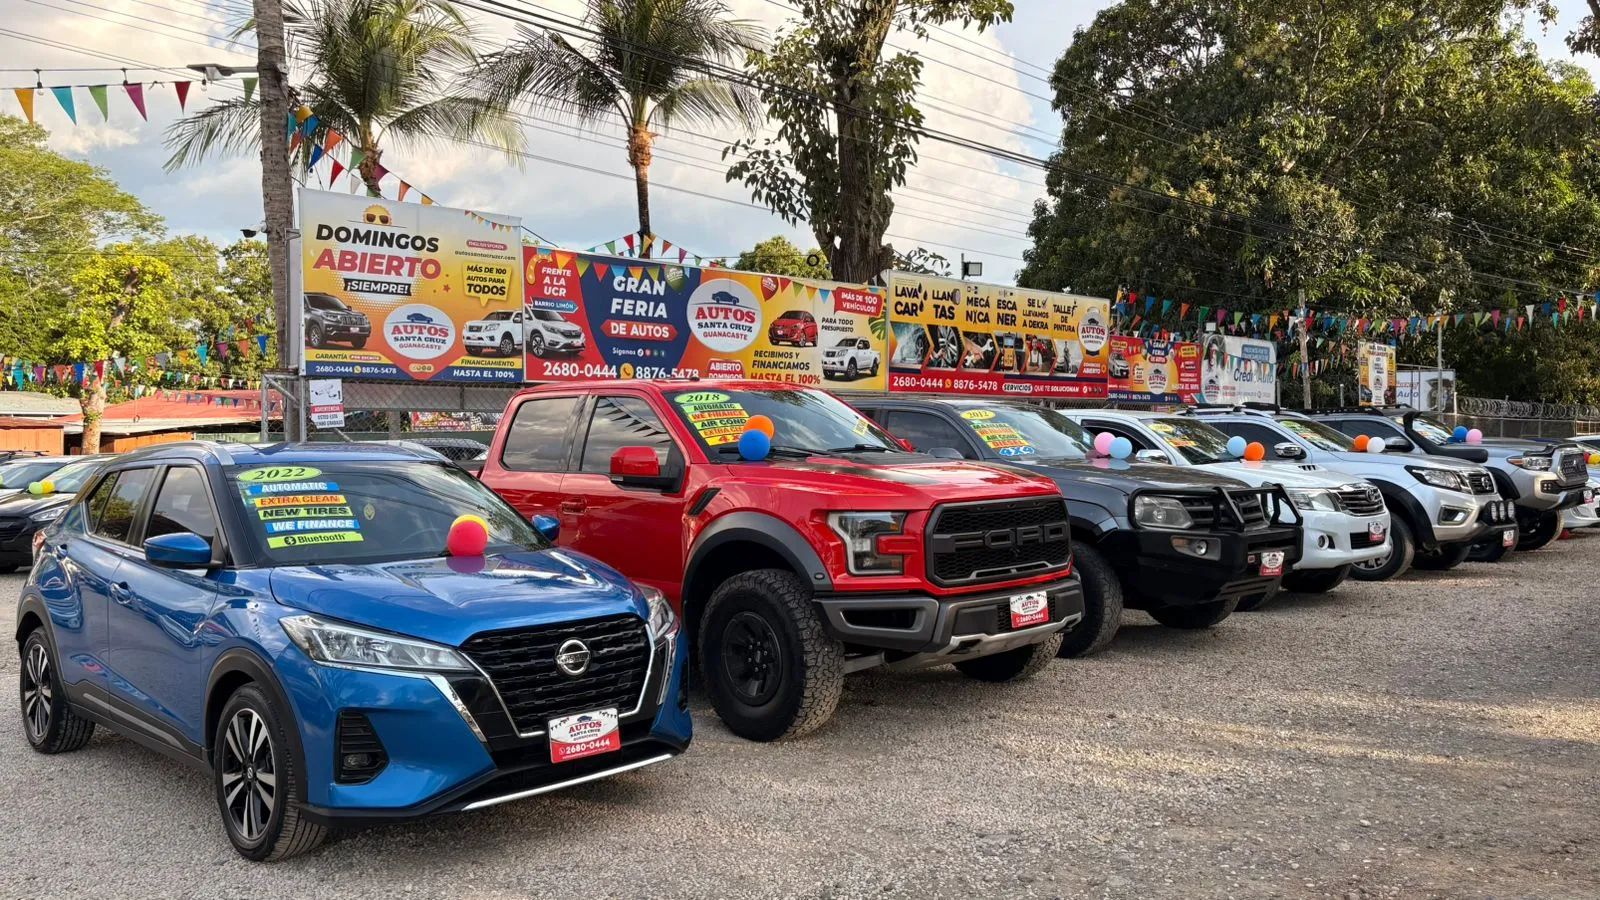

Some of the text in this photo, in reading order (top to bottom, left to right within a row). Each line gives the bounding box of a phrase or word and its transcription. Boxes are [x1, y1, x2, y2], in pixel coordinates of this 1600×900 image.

[316, 224, 439, 253] DOMINGOS
[313, 248, 441, 280] ABIERTO
[467, 264, 483, 273] MÁS
[542, 266, 572, 277] FRENTE
[466, 275, 488, 283] AUTOS
[543, 276, 566, 286] A LA
[347, 281, 410, 295] ¡SIEMPRE!
[467, 284, 506, 296] TODOS
[544, 286, 566, 296] UCR
[613, 276, 666, 296] GRAN
[895, 286, 919, 299] LAVA
[856, 294, 864, 302] DE
[864, 296, 878, 305] 100
[966, 296, 990, 308] MECÁ
[1028, 298, 1036, 308] SE
[556, 301, 574, 310] LIMÓN
[611, 298, 667, 318] FERIA
[894, 301, 919, 317] CAR
[996, 299, 1017, 312] ESCA
[695, 306, 756, 324] AUTOS
[933, 304, 955, 320] TAS
[1022, 309, 1049, 319] LLEVAMOS
[822, 316, 854, 326] PARA TODO
[996, 312, 1016, 326] NER
[1060, 316, 1068, 324] DE
[611, 322, 670, 338] DE AUTOS
[698, 322, 752, 333] SANTA CRUZ
[822, 324, 854, 334] PRESUPUESTO
[1022, 320, 1049, 330] A DEKRA
[1054, 324, 1075, 333] PINTURA
[1082, 326, 1105, 335] AUTOS
[392, 324, 449, 338] AUTOS
[703, 331, 748, 340] GUANACASTE
[424, 336, 447, 344] CRUZ
[399, 342, 441, 350] GUANACASTE
[612, 347, 636, 356] Síganos
[315, 352, 348, 360] GARANTÍA
[754, 350, 794, 359] RECIBIMOS
[461, 358, 515, 368] FINANCIAMIENTO
[710, 362, 741, 371] ABIERTO
[752, 360, 810, 370] FINANCIAMOS
[316, 366, 397, 375] 2680-0444 8876-5478
[454, 370, 515, 379] HASTA EL 100%
[543, 362, 700, 380] 2680-0444 8876-5478
[750, 372, 821, 384] HASTA EL 100%
[894, 376, 998, 391] 2680-0444 8876-5478
[1004, 384, 1032, 392] SERVICIOS
[686, 394, 720, 402] 2018
[704, 428, 730, 436] EXTRA
[252, 467, 306, 480] 2022
[262, 482, 328, 493] AUTOMATIC
[261, 495, 338, 506] EXTRA CLEAN
[262, 507, 347, 518] NEW TIRES
[272, 519, 355, 531] WE FINANCE
[297, 532, 345, 544] Bluetooth
[933, 521, 1068, 554] FORD
[1022, 600, 1039, 608] AUTOS
[569, 721, 602, 734] AUTOS
[566, 738, 610, 754] 2680-0444
